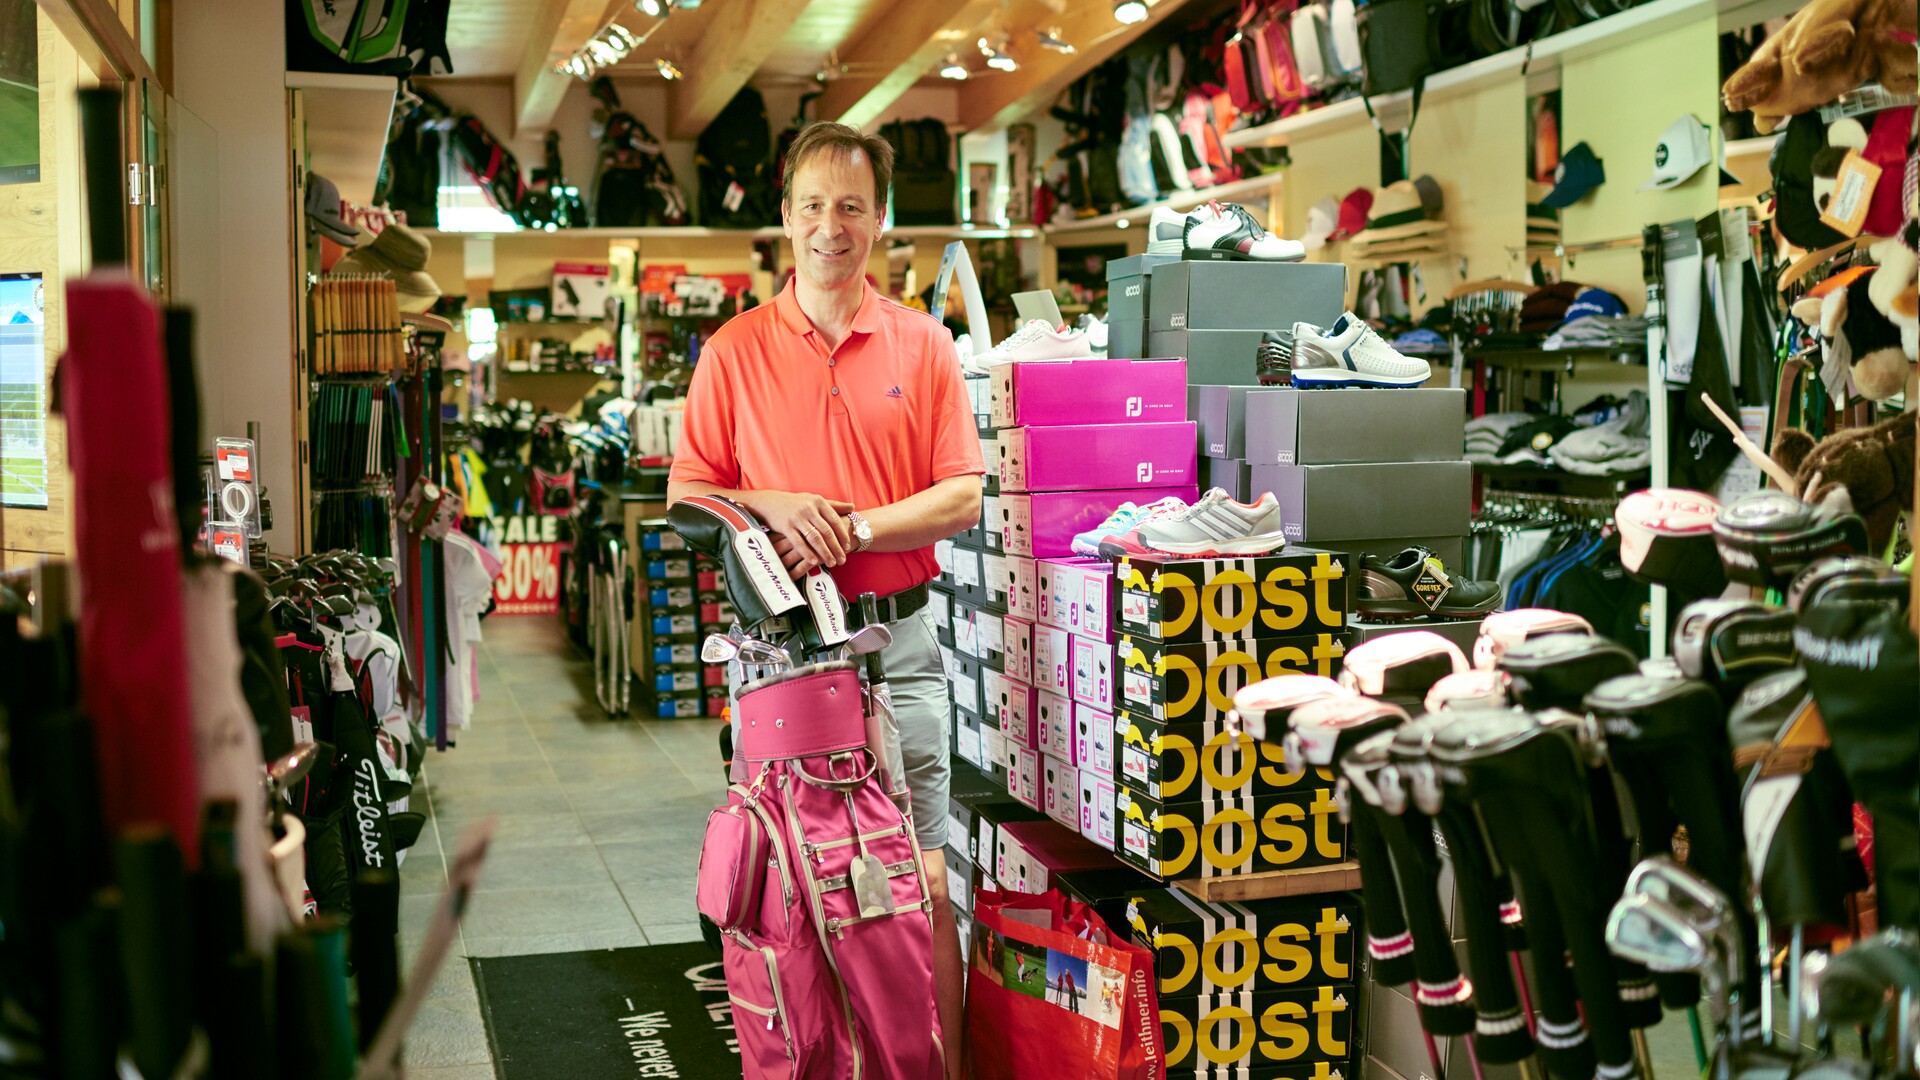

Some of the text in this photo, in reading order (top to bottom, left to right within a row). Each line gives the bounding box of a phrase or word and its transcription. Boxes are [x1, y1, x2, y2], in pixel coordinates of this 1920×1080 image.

[1125, 284, 1141, 297] ecco
[1170, 315, 1186, 327] ecco
[1126, 396, 1142, 417] FJ
[1210, 443, 1224, 453] ecco
[1277, 453, 1294, 463] ecco
[1137, 462, 1153, 483] FJ
[494, 515, 558, 543] SALE
[1284, 525, 1302, 536] ecco
[496, 544, 558, 600] 30%
[747, 537, 791, 602] TaylorMade
[814, 580, 839, 637] TaylorMade
[1070, 602, 1079, 626] FJ
[1099, 678, 1107, 703] FJ
[1080, 739, 1088, 763] FJ
[353, 758, 385, 868] Titleist
[1083, 806, 1092, 830] FJ
[618, 1010, 672, 1038] We
[628, 1039, 680, 1079] never
